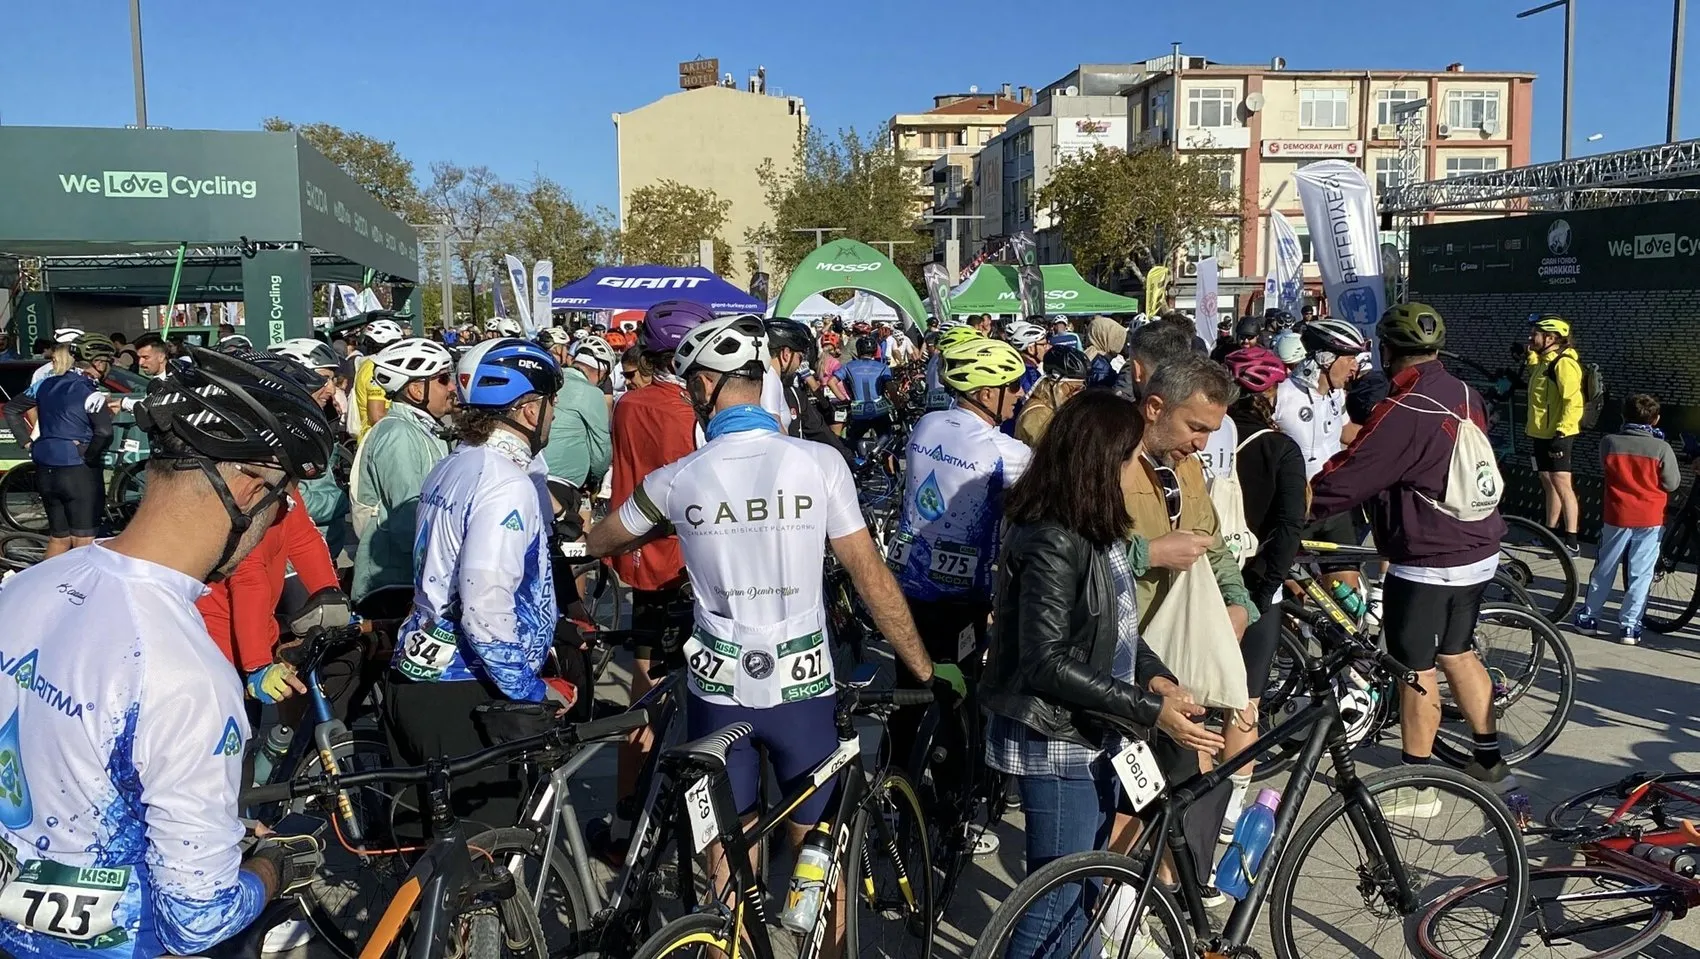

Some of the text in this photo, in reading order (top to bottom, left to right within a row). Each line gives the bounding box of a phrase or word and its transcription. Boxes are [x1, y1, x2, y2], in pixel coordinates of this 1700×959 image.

[684, 74, 713, 86] HOTEL
[1282, 142, 1322, 151] DEMOKRAT
[58, 174, 258, 199] We Love Cycling
[1608, 240, 1632, 257] We
[1636, 237, 1672, 256] Love
[815, 261, 882, 273] MOSSO
[596, 276, 712, 289] GIANT
[268, 275, 283, 319] Cycling
[552, 297, 592, 305] GIANT
[711, 302, 758, 310] giant-turkey.com
[684, 489, 813, 529] ÇABİP
[938, 552, 970, 575] 975
[690, 648, 725, 680] 627
[791, 648, 822, 681] 627
[22, 889, 100, 936] 725
